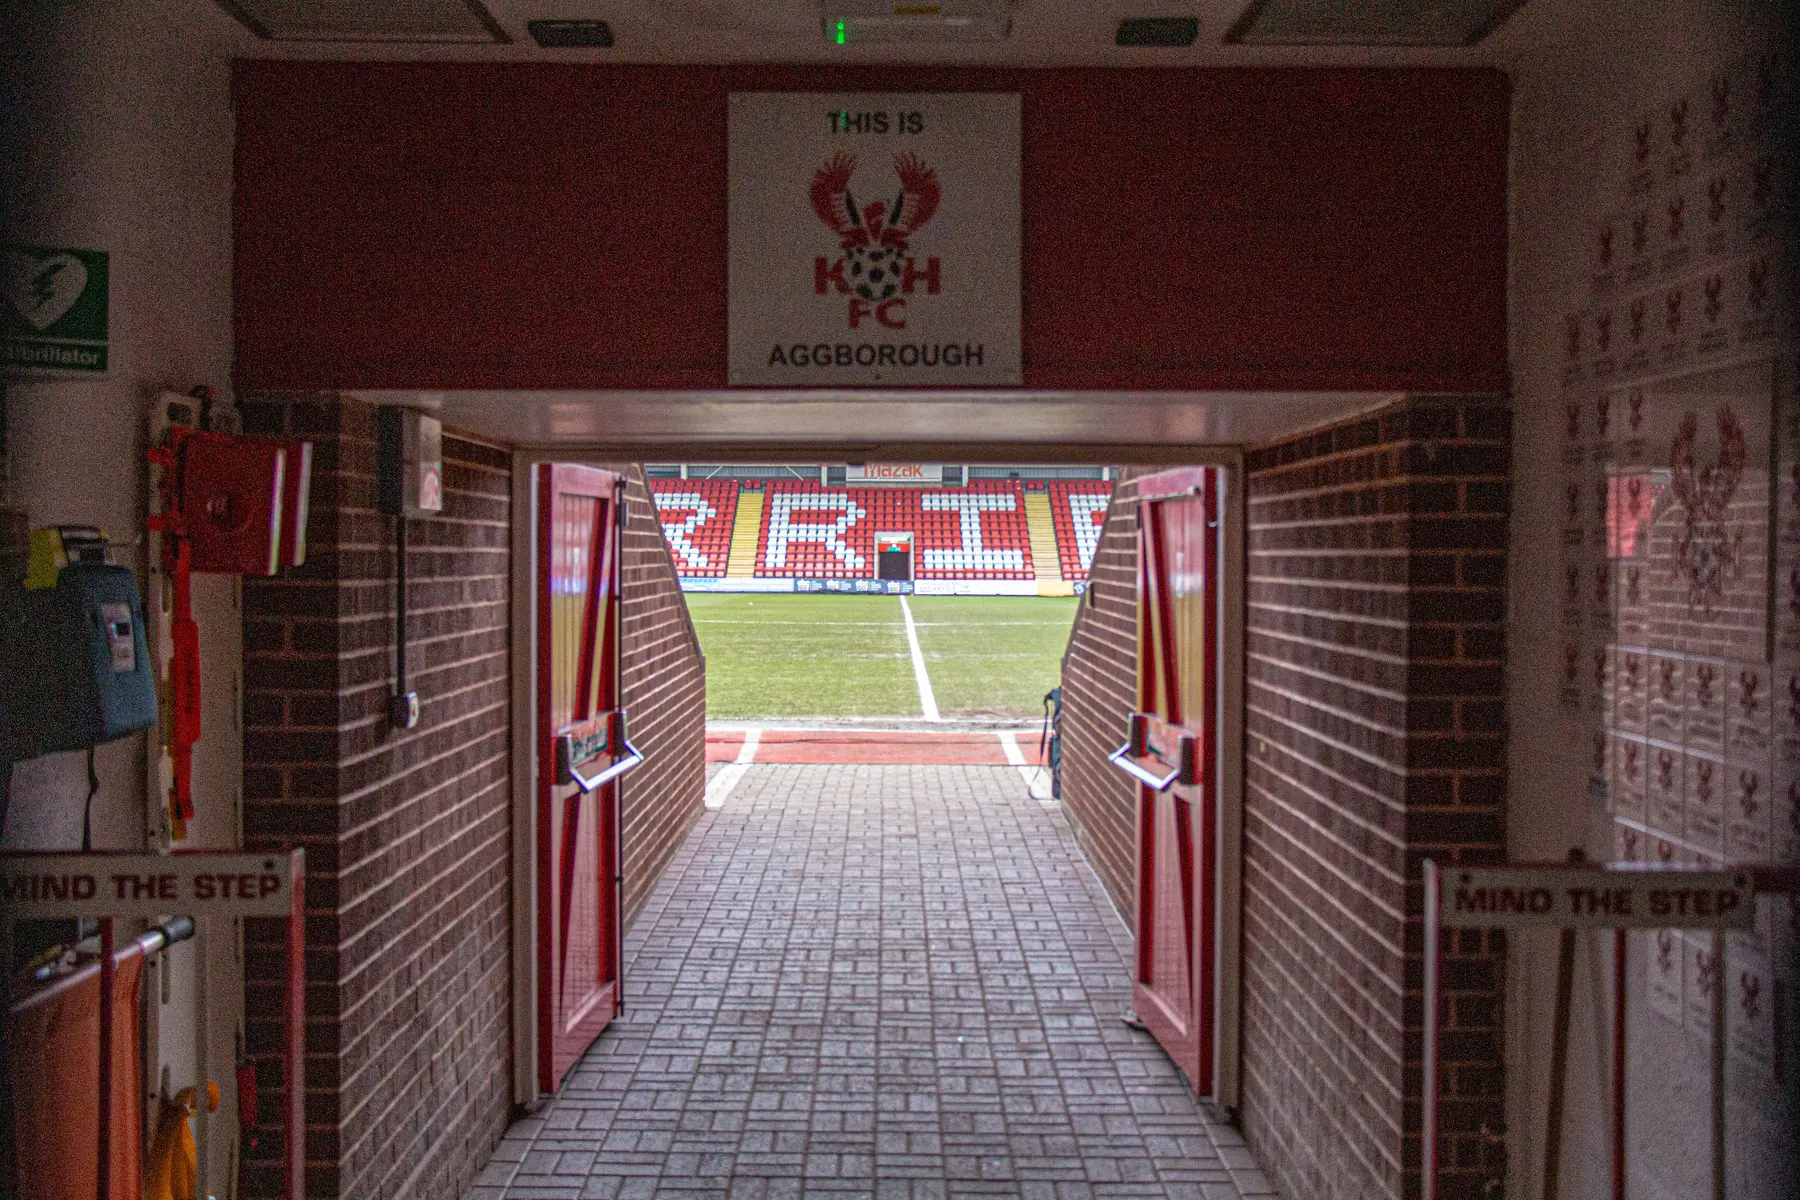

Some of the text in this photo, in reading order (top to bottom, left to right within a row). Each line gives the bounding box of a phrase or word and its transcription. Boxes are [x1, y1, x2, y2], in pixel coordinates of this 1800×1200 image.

[827, 110, 923, 134] THIS IS
[849, 299, 905, 329] FC
[768, 343, 984, 367] AGGBOROUGH
[0, 873, 281, 900] MIND THE STEP
[1454, 886, 1740, 916] MIND THE STEP
